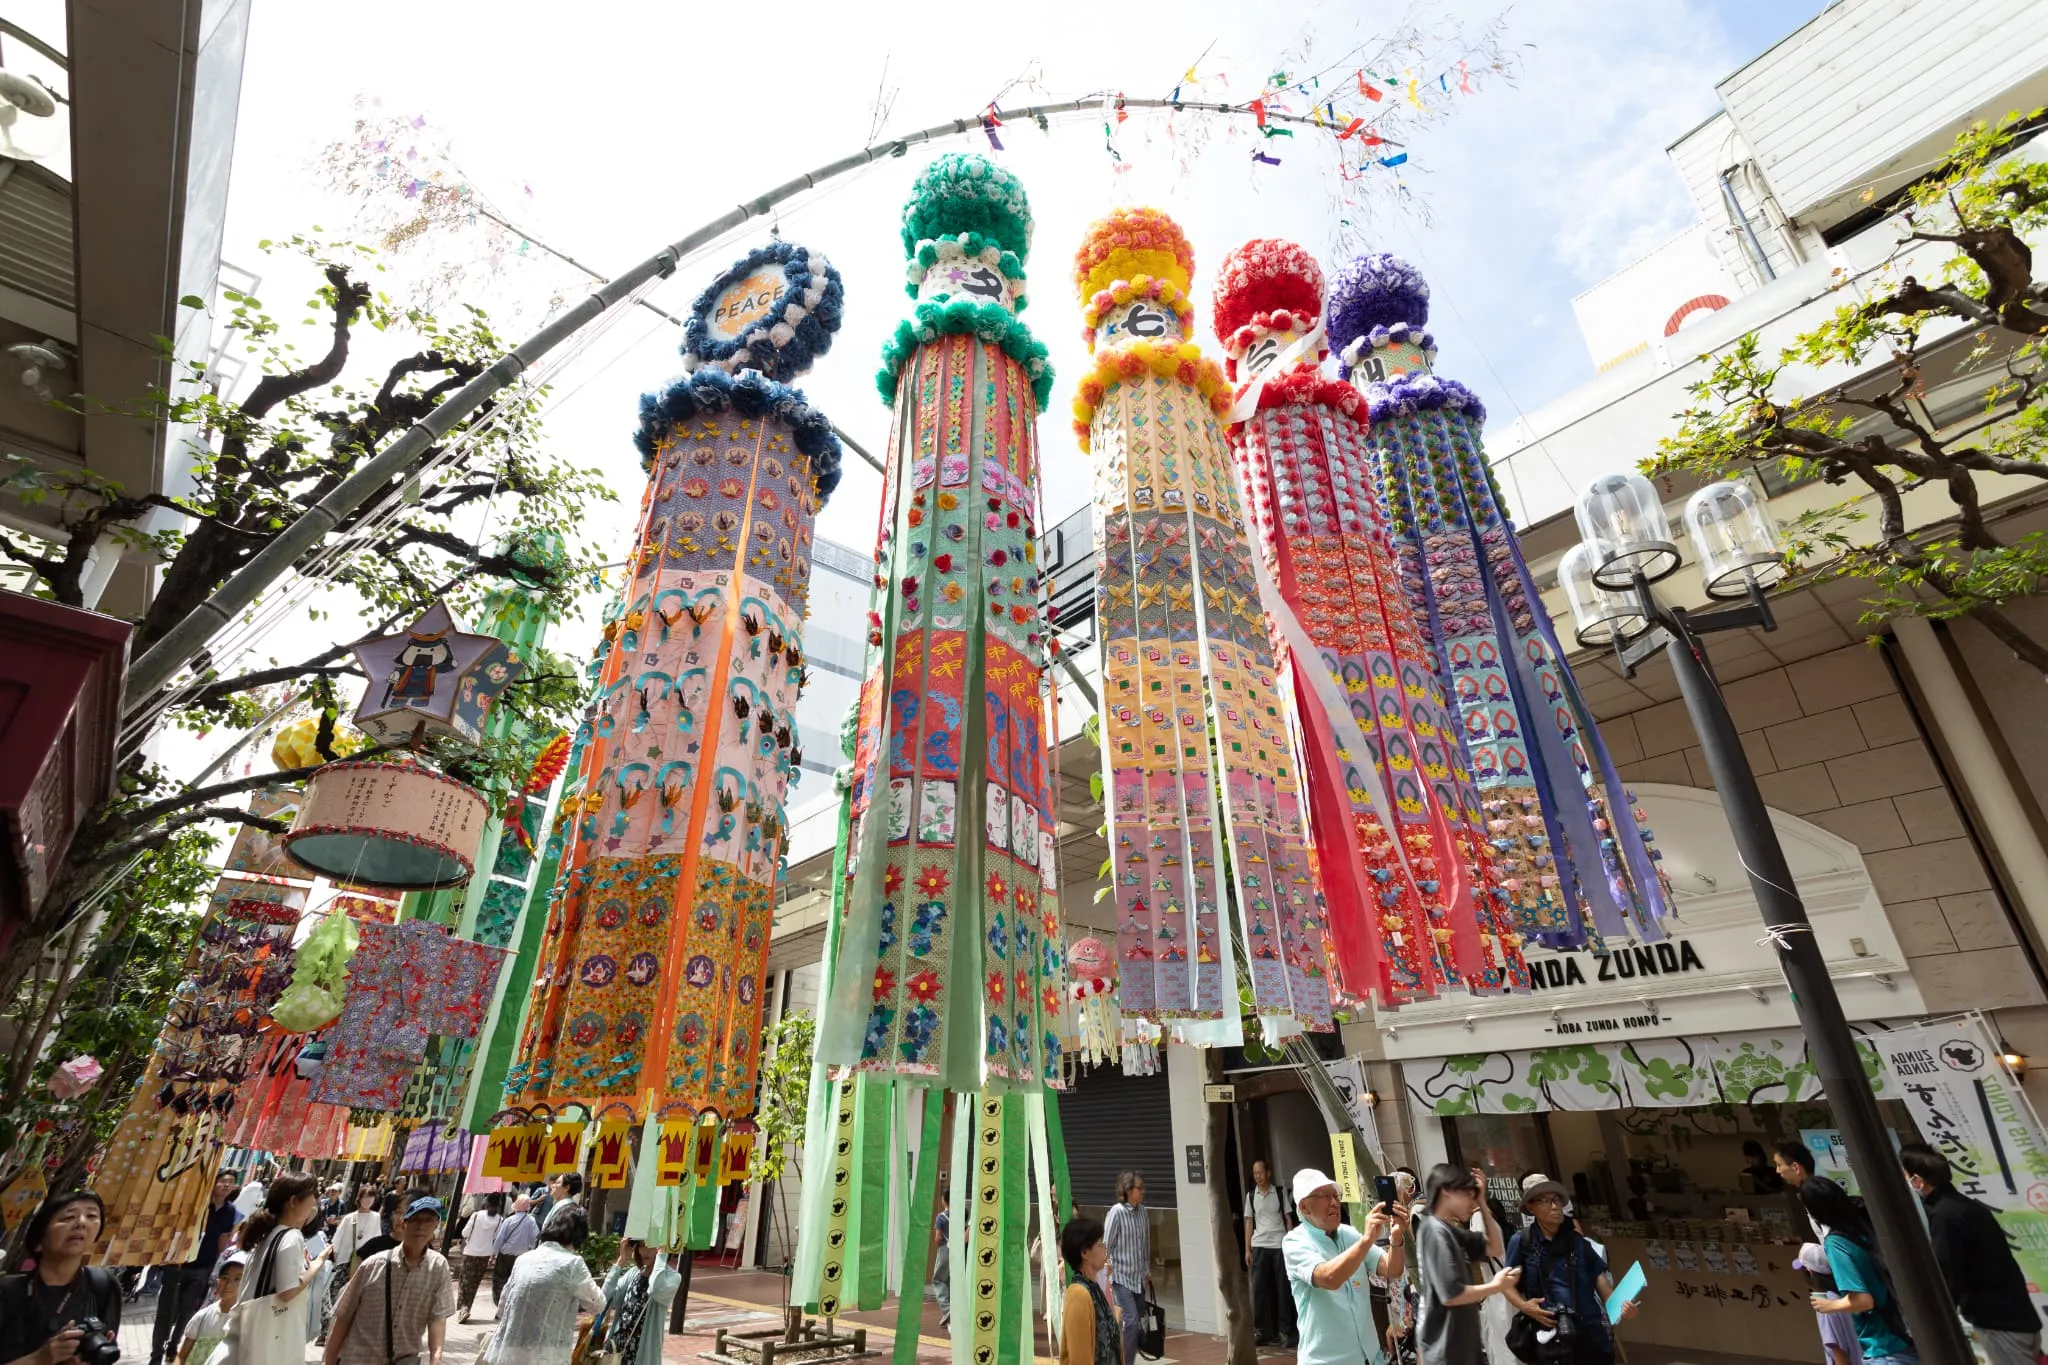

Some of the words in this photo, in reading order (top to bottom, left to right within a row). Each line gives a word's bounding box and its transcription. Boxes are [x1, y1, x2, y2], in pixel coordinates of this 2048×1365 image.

[714, 285, 785, 323] PEACE
[1498, 957, 1587, 994] NDA
[1594, 940, 1705, 982] ZUNDA
[1557, 1023, 1582, 1034] AOBA
[1587, 1019, 1620, 1033] ZUNDA
[1623, 1014, 1660, 1029] HONPO
[1487, 1177, 1520, 1189] ZUNDA
